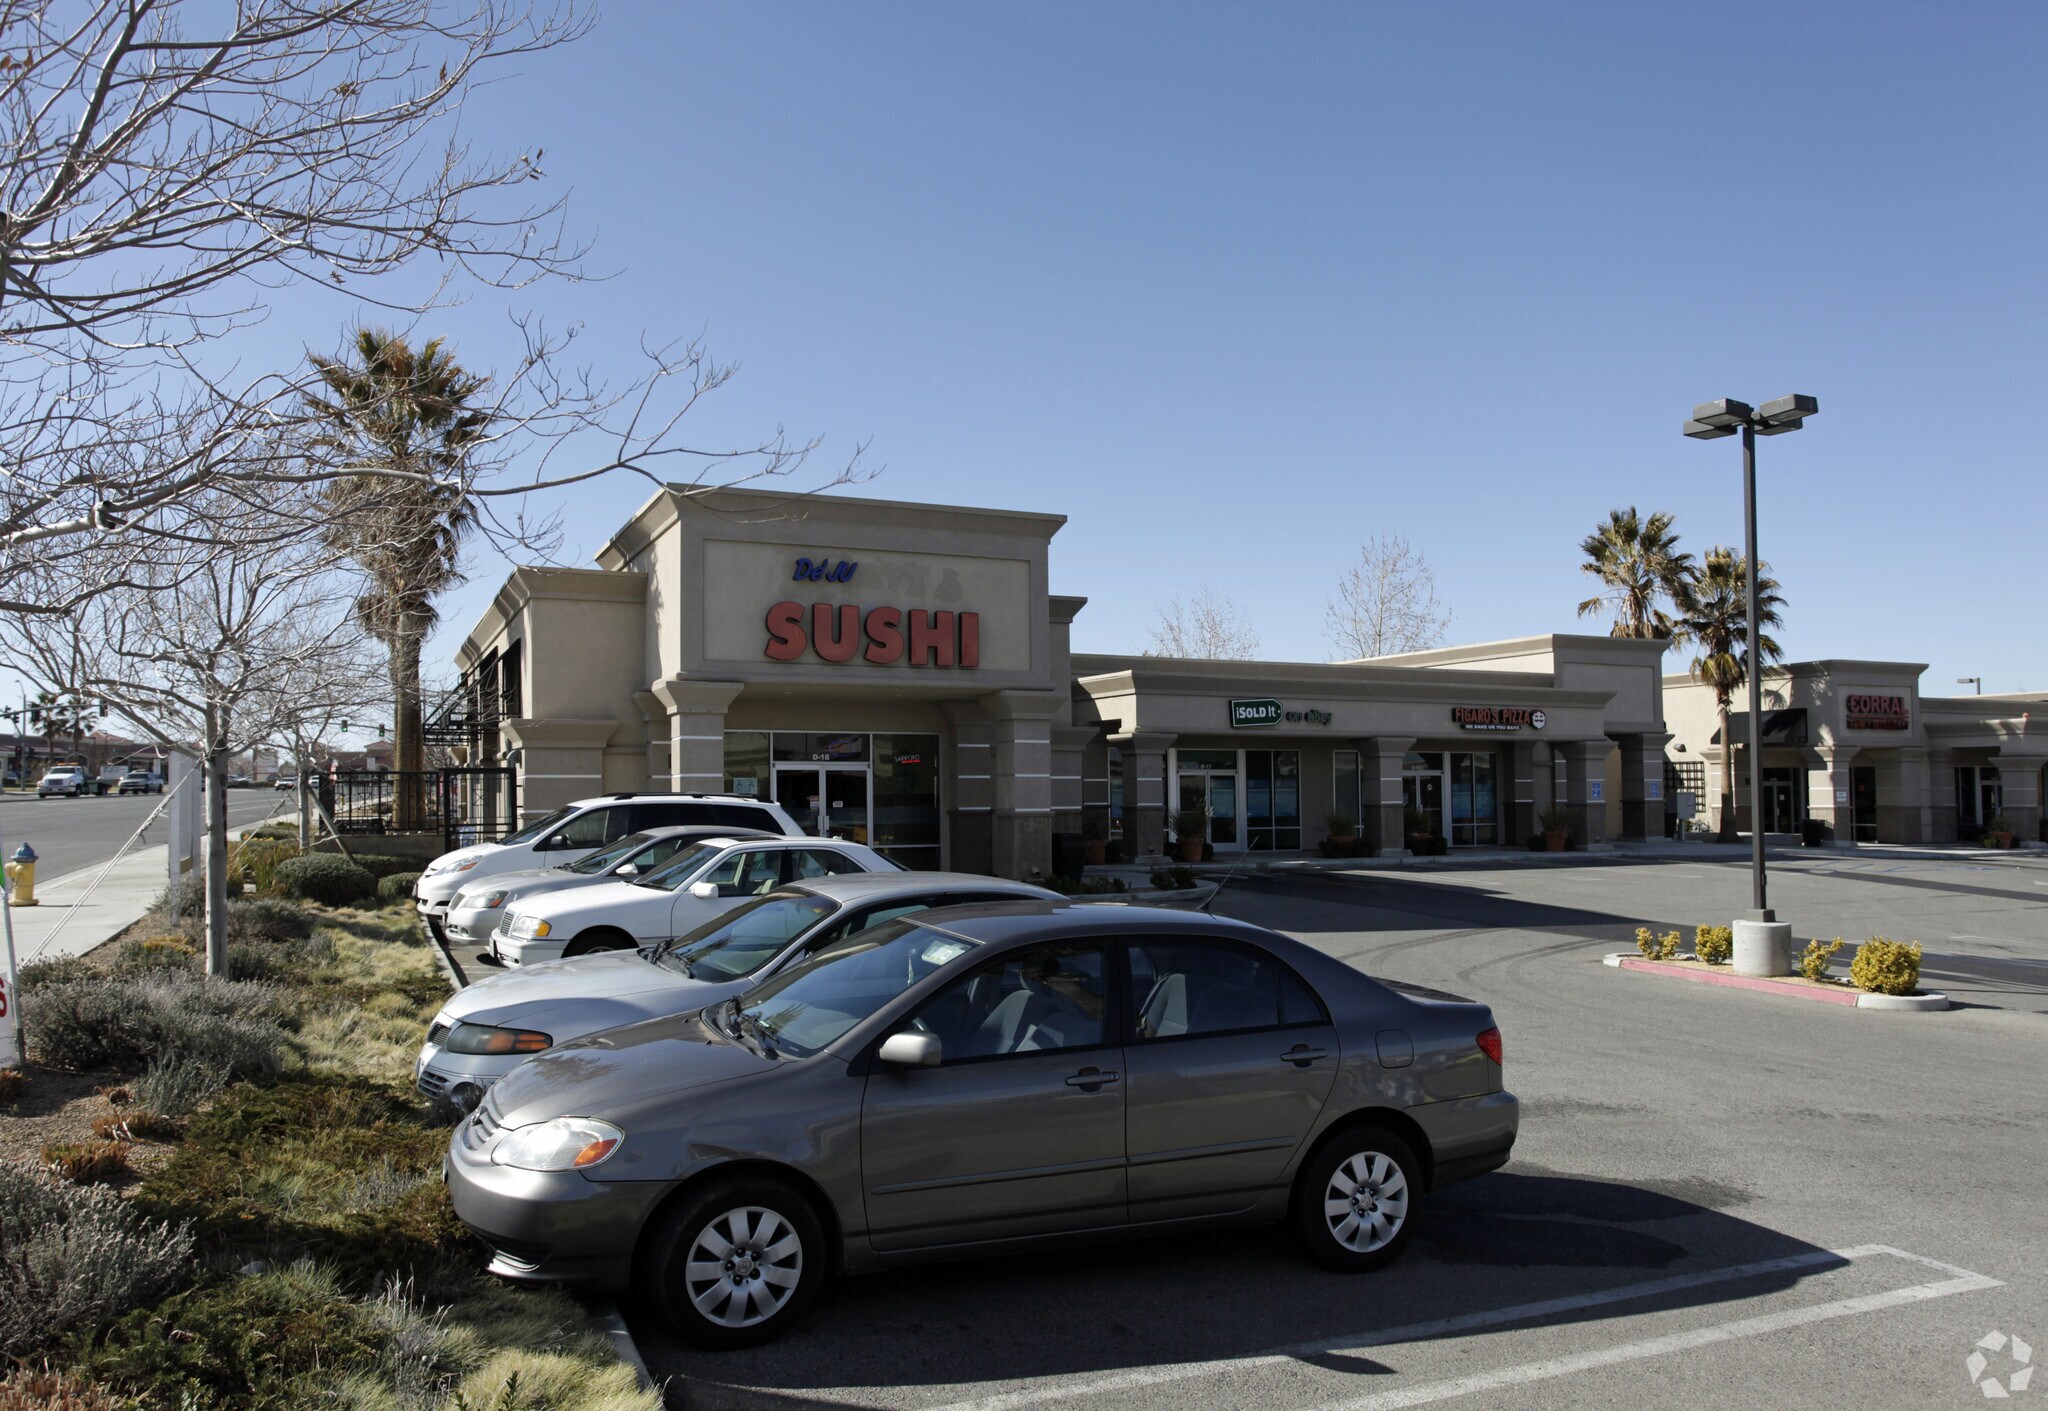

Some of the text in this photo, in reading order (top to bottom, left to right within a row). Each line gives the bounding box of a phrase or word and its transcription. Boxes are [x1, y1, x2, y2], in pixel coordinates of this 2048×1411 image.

[764, 601, 979, 667] SUSHI
[1847, 694, 1909, 714] CORRAL
[1454, 706, 1531, 724] FIGARO'S PIZZA
[812, 753, 830, 761] D-18
